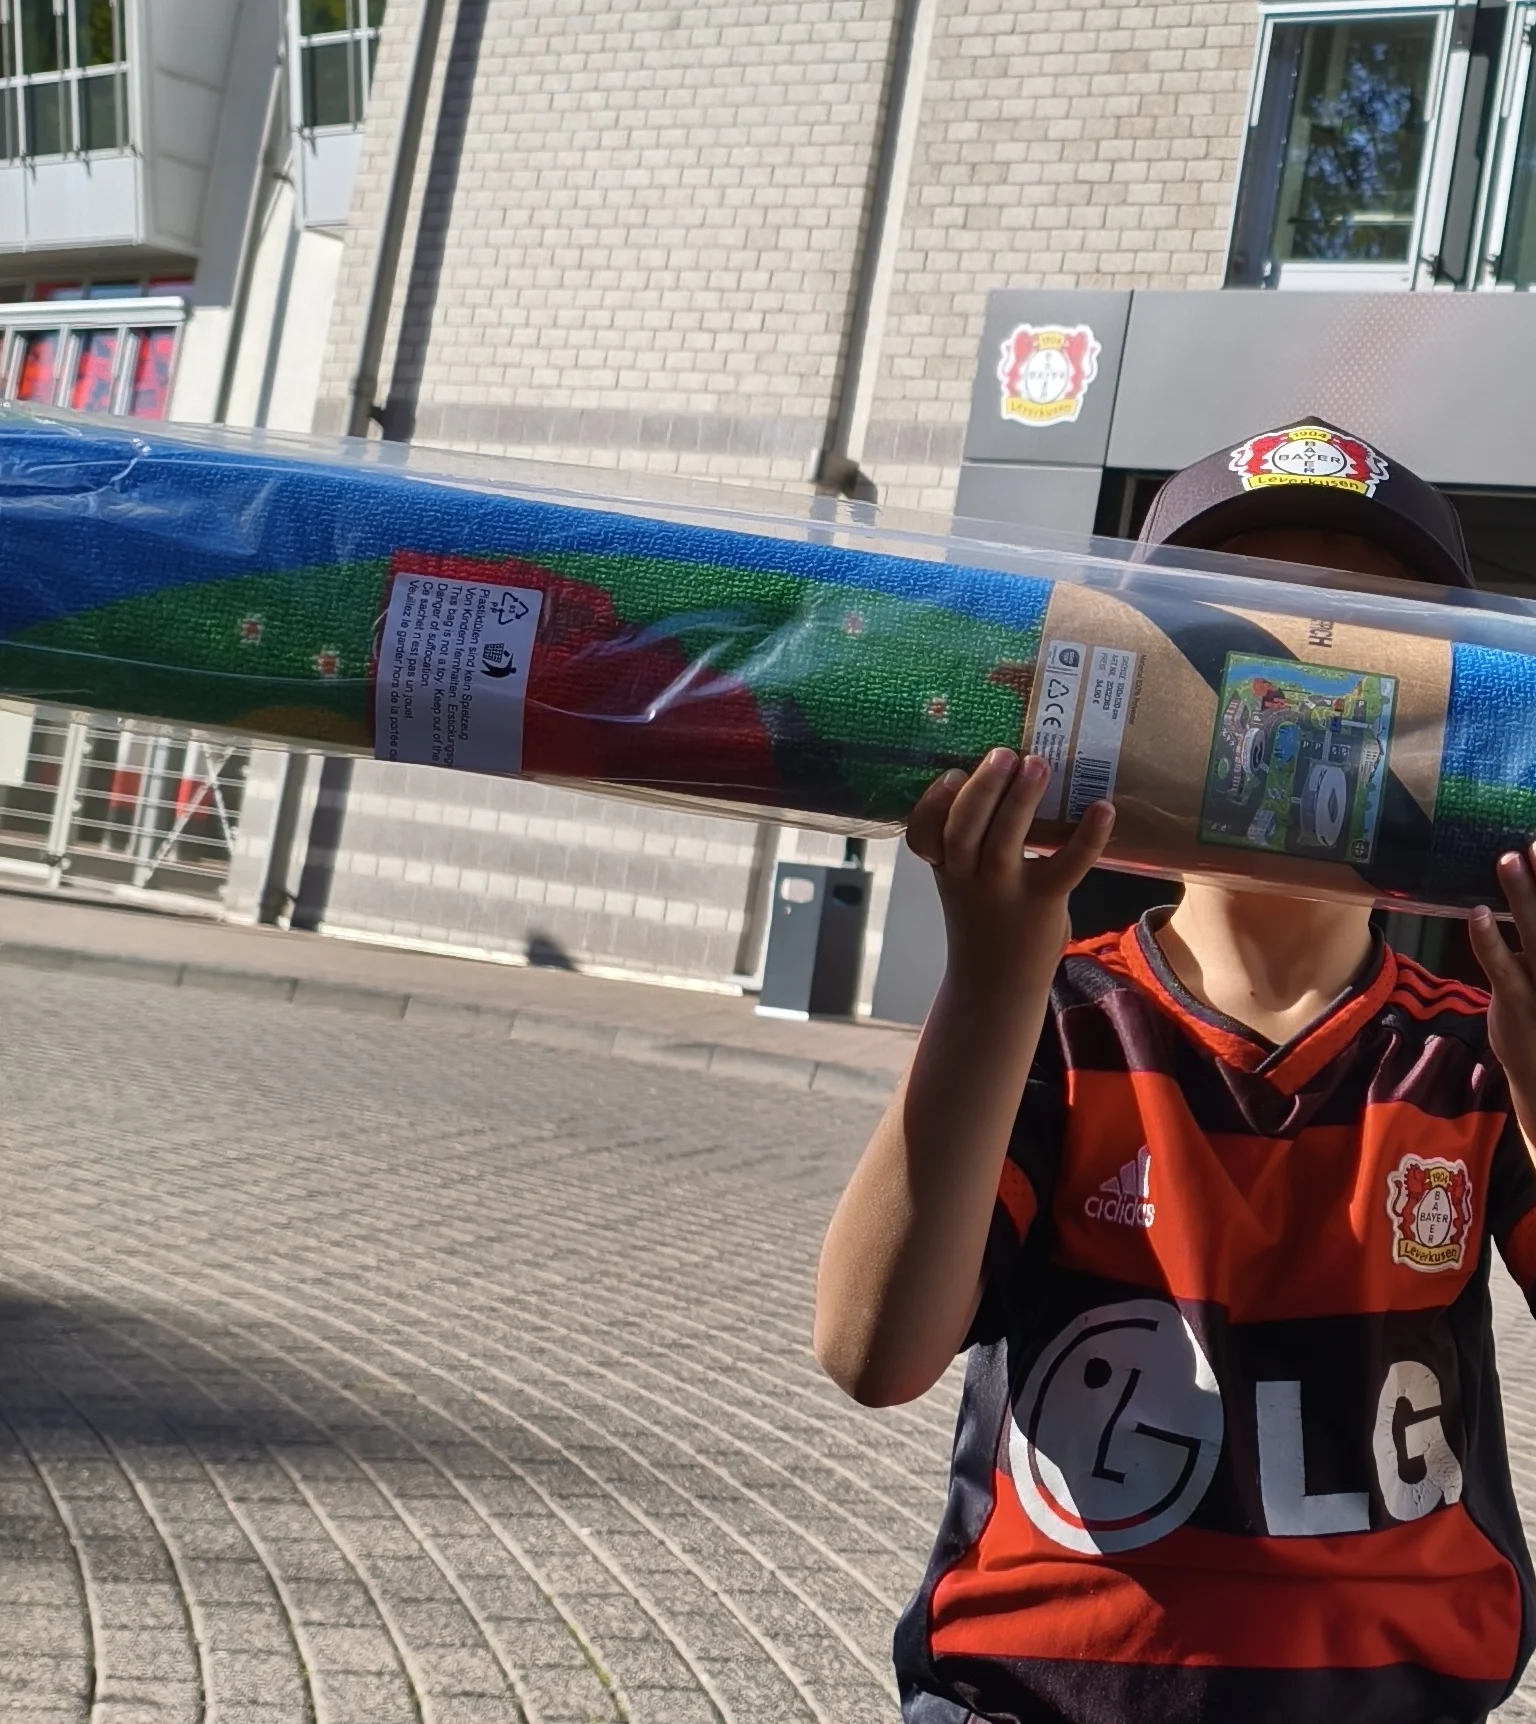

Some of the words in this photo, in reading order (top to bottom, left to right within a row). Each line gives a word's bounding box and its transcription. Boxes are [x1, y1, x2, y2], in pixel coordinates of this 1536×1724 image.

[1293, 430, 1328, 440] 1904
[1278, 453, 1342, 464] BAYER
[402, 579, 419, 617] Veuillez
[422, 581, 433, 596] Ce
[449, 586, 462, 606] This
[464, 587, 476, 606] Von
[432, 583, 448, 619] Danger
[401, 619, 412, 628] le
[414, 599, 429, 630] sachet
[443, 608, 458, 627] bag
[431, 621, 442, 630] of
[456, 608, 472, 646] Kindern
[393, 631, 408, 664] garder
[440, 640, 452, 656] not
[466, 647, 478, 667] sind
[391, 666, 403, 688] hors
[404, 659, 416, 677] pas
[405, 680, 414, 692] un
[463, 670, 474, 691] kein
[390, 691, 401, 704] de
[431, 688, 444, 714] Keep
[390, 706, 400, 714] la
[459, 694, 472, 740] Spielzeug
[433, 716, 442, 731] out
[432, 733, 442, 744] of
[432, 745, 442, 761] the
[1084, 1192, 1155, 1228] adidas
[1420, 1212, 1449, 1224] BAYER
[1404, 1242, 1457, 1262] Leverkusen
[1255, 1360, 1463, 1536] LG
